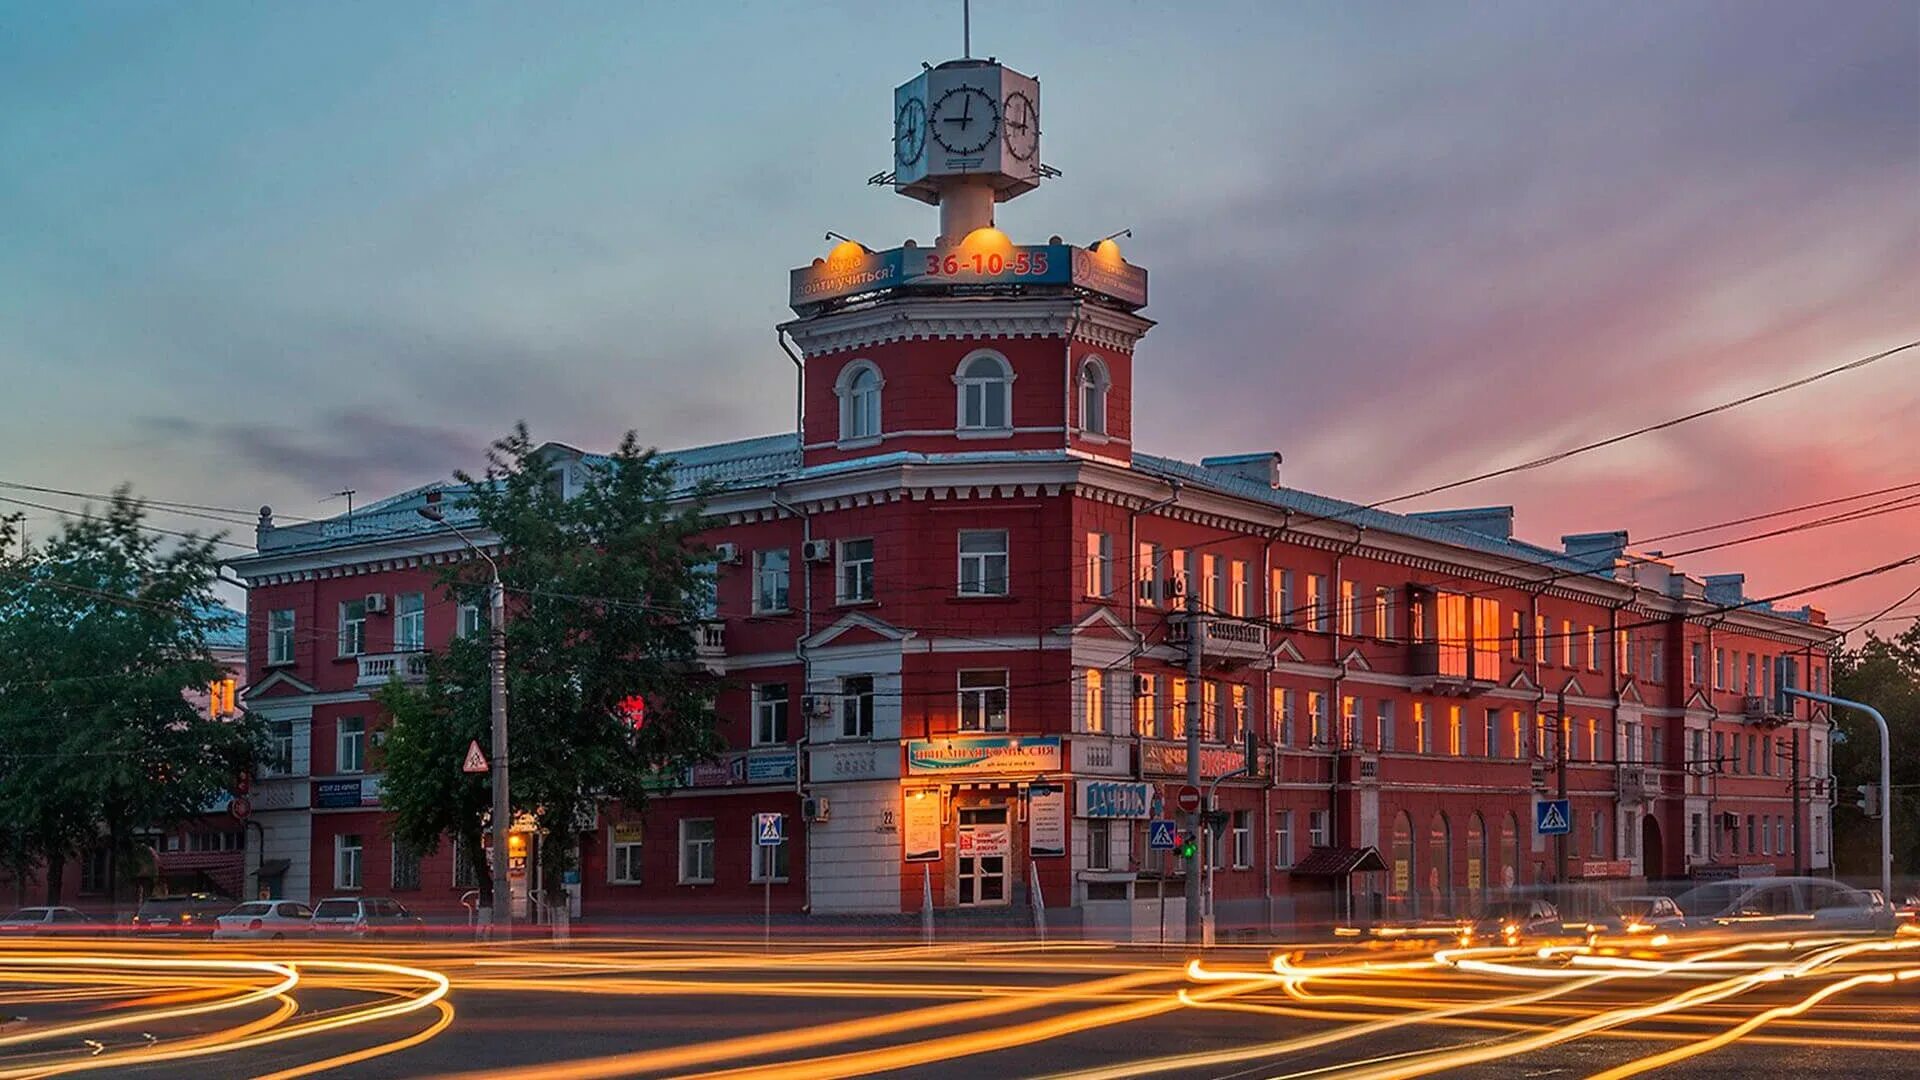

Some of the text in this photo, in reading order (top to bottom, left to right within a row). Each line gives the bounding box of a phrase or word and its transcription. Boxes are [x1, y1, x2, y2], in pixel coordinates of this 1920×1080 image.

[830, 256, 862, 272] Куда
[926, 253, 1048, 275] 36-10-55
[836, 264, 895, 291] учиться?
[1087, 783, 1146, 816] ДАЧНИК
